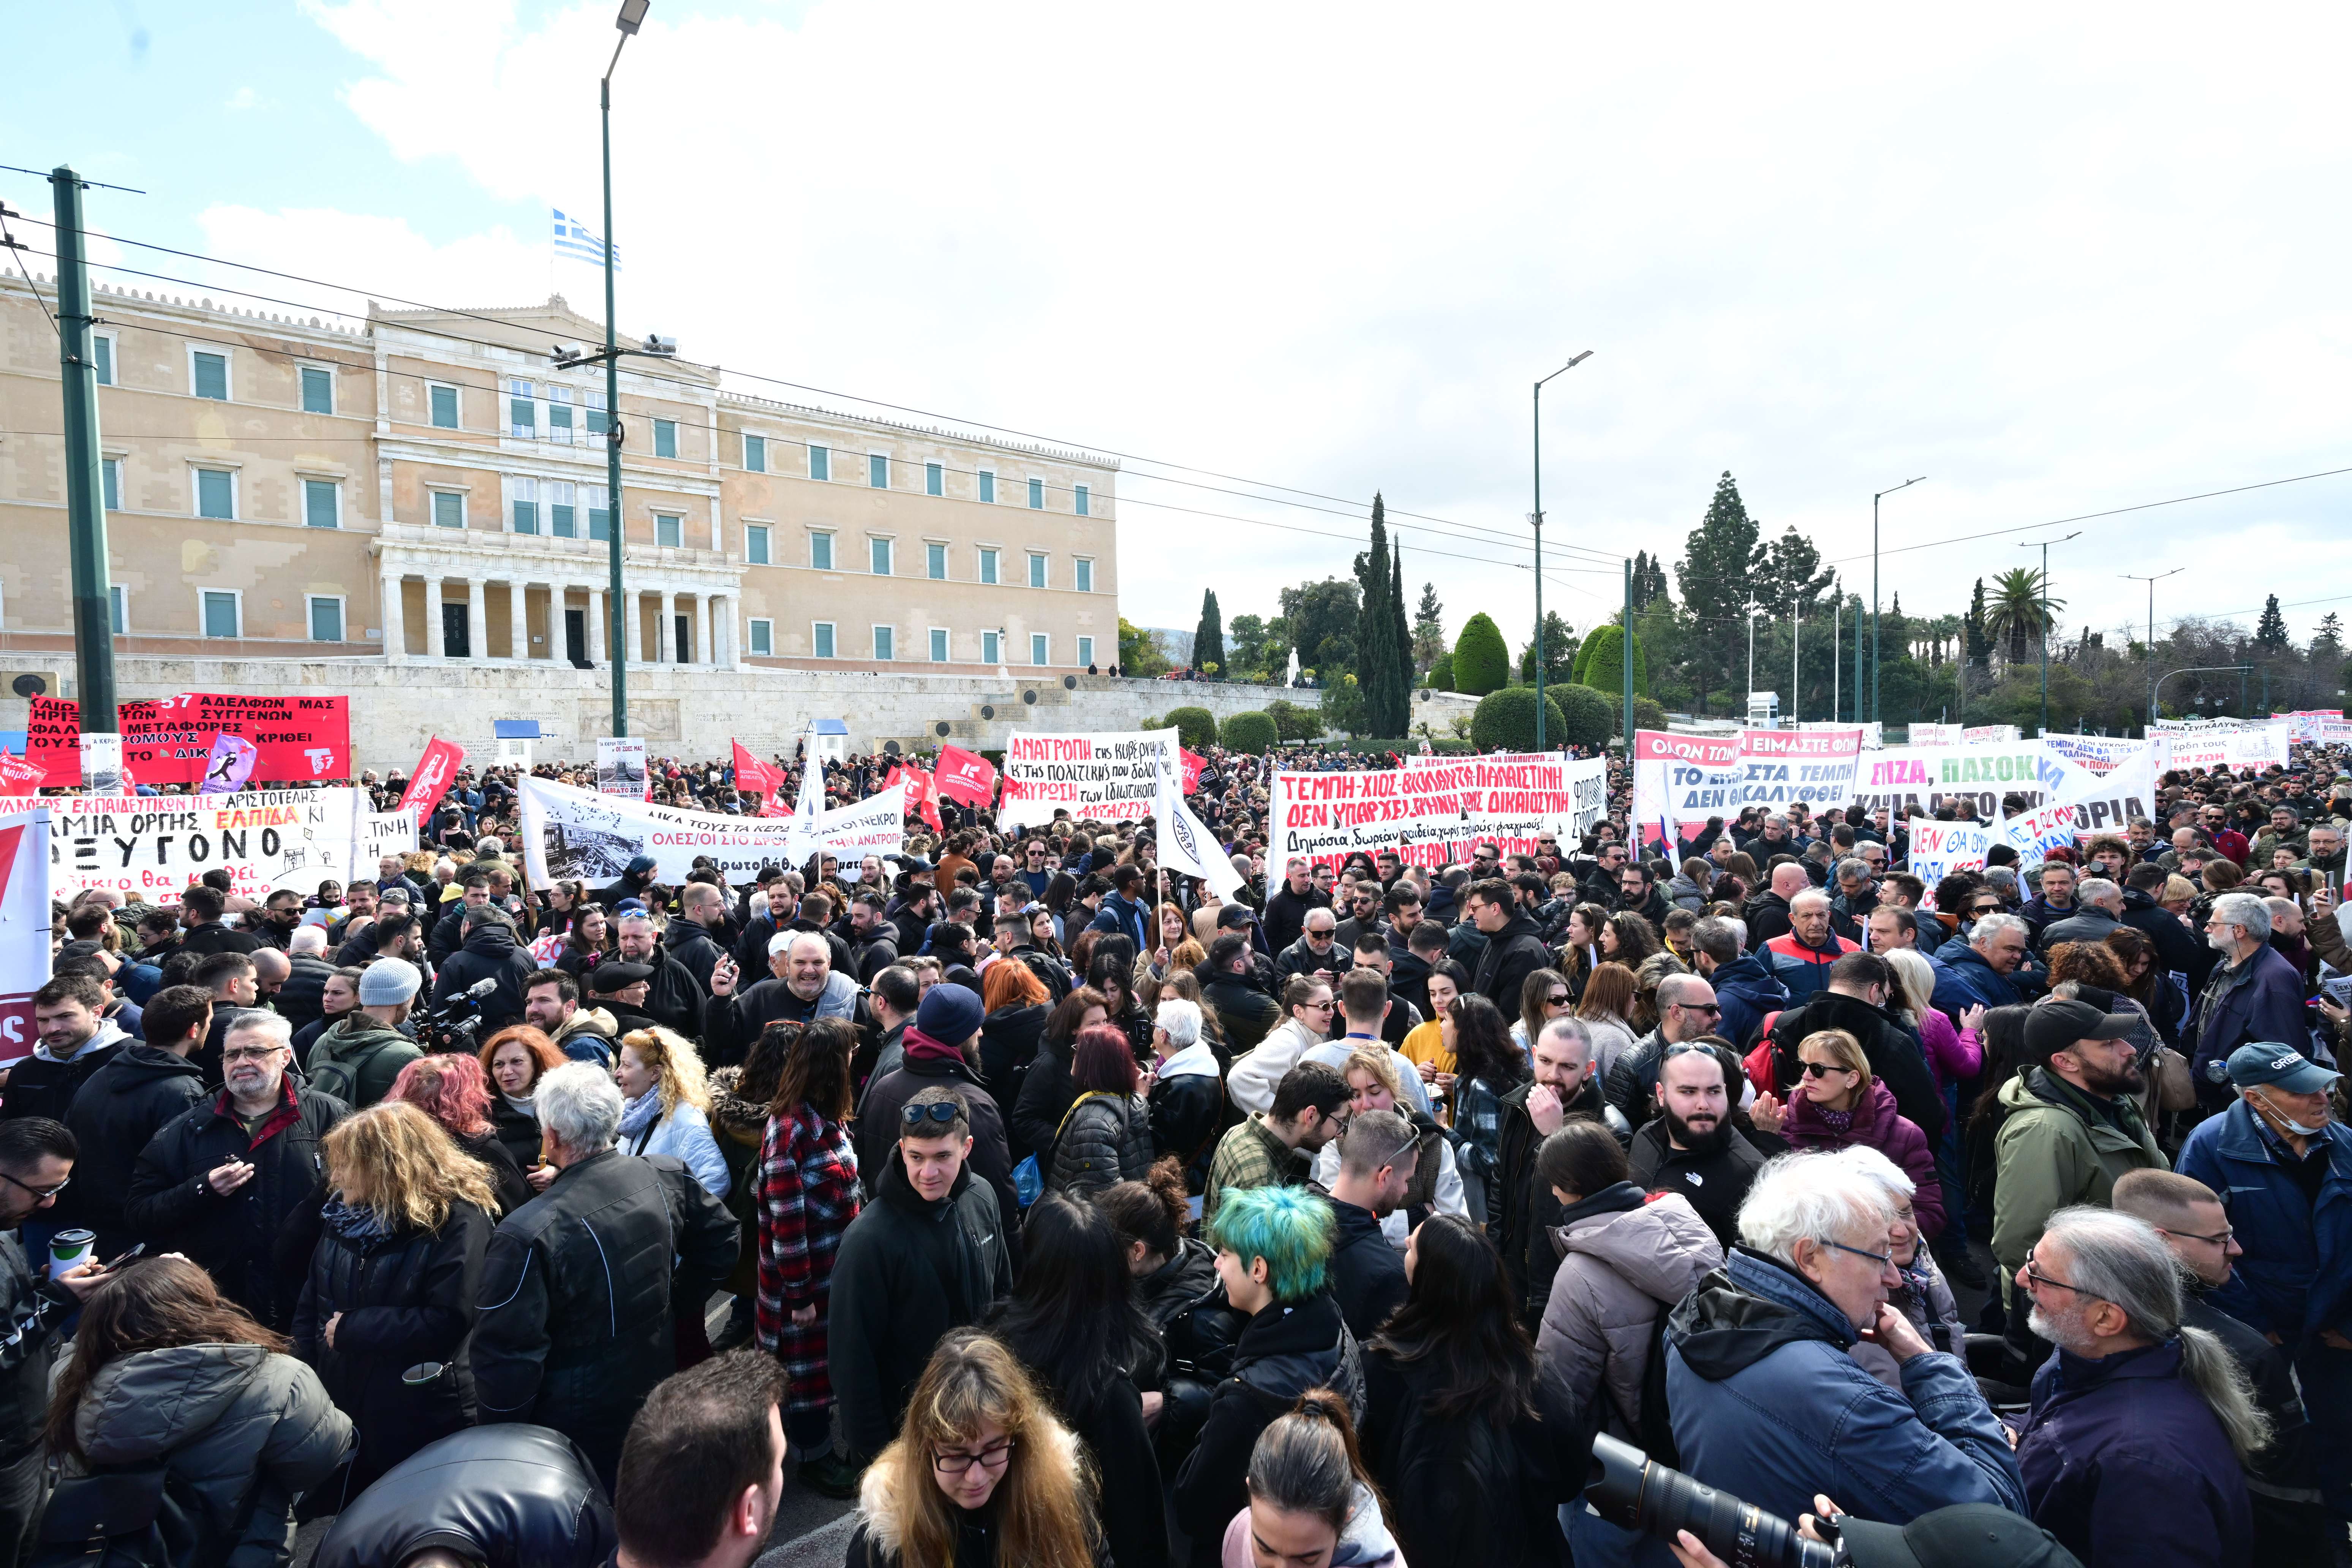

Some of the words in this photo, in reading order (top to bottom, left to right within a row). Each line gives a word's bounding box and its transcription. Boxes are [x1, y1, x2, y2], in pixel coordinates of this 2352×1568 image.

[161, 695, 192, 708] 57
[200, 696, 285, 708] ΑΔΕΛΦΩΝ
[299, 700, 334, 709] ΜΑΣ
[30, 710, 79, 722] ΗΡΙΞ
[119, 710, 156, 720] ΤΩΝ
[200, 710, 292, 720] ΣΥΓΓΕΝΩΝ
[128, 721, 243, 734] ΜΕΤΑΦΟΡΕΣ
[2188, 722, 2243, 731] ΣΥΓΚΑΛΥΨΗ
[256, 733, 312, 743] ΚΡΙΘΕΙ
[1012, 738, 1092, 761] ΑΝΑΤΡΟΠΗ
[1652, 739, 1704, 761] ΟΛΩΝ
[1709, 746, 1736, 761] ΤΩΝ
[1752, 737, 1829, 753] ΕΙΜΑΣΤΕ
[1832, 736, 1858, 753] ΦΩΝΗ
[2077, 743, 2094, 753] ΔΕΝ
[127, 751, 153, 762] ΤΟ
[2195, 752, 2224, 762] ΖΩΗ
[2089, 760, 2122, 770] ΠΟΛΙΤ
[2, 766, 32, 780] Νήμα
[1198, 775, 1211, 784] ΟΥΛΗΣΑΝ
[1674, 767, 1703, 786] ΤΟ
[1743, 764, 1789, 781] ΣΤΑ
[1800, 763, 1853, 781] ΤΕΜΠΗ
[945, 778, 983, 793] ΑΠΕΛΕΥΘΕΡΩΣΗ
[946, 773, 985, 790] ΚΟΜΜΟΥΝΙΣΤΙΚΗ
[1081, 787, 1102, 803] των
[1682, 789, 1725, 808] ΔΕΝ
[72, 797, 186, 813] ΕΚΠΑΙΔΕΥΤΙΚΩΝ
[1287, 804, 1328, 827] ΔΕΝ
[1333, 800, 1408, 827] ΥΠΑΡΧΕΙ
[1488, 790, 1569, 813] ΔΙΚΑΙΟΣΥΝΗ
[216, 806, 299, 829] ΕΛΠΙΔΑ
[309, 806, 323, 823] ΚΙ
[841, 820, 858, 829] ΟΙ
[859, 813, 897, 827] ΝΕΚΡΟΙ
[652, 833, 716, 846] ΟΛΕΣ/ΟΙ
[721, 835, 749, 846] ΣΤΟ
[858, 833, 900, 846] ΑΝΑΤΡΟΠΗ
[1355, 828, 1399, 848] δωρεάν
[1914, 827, 1944, 854] ΔΕΝ
[1946, 830, 1966, 853] ΘΑ
[142, 870, 173, 888] θα
[159, 893, 183, 903] στ
